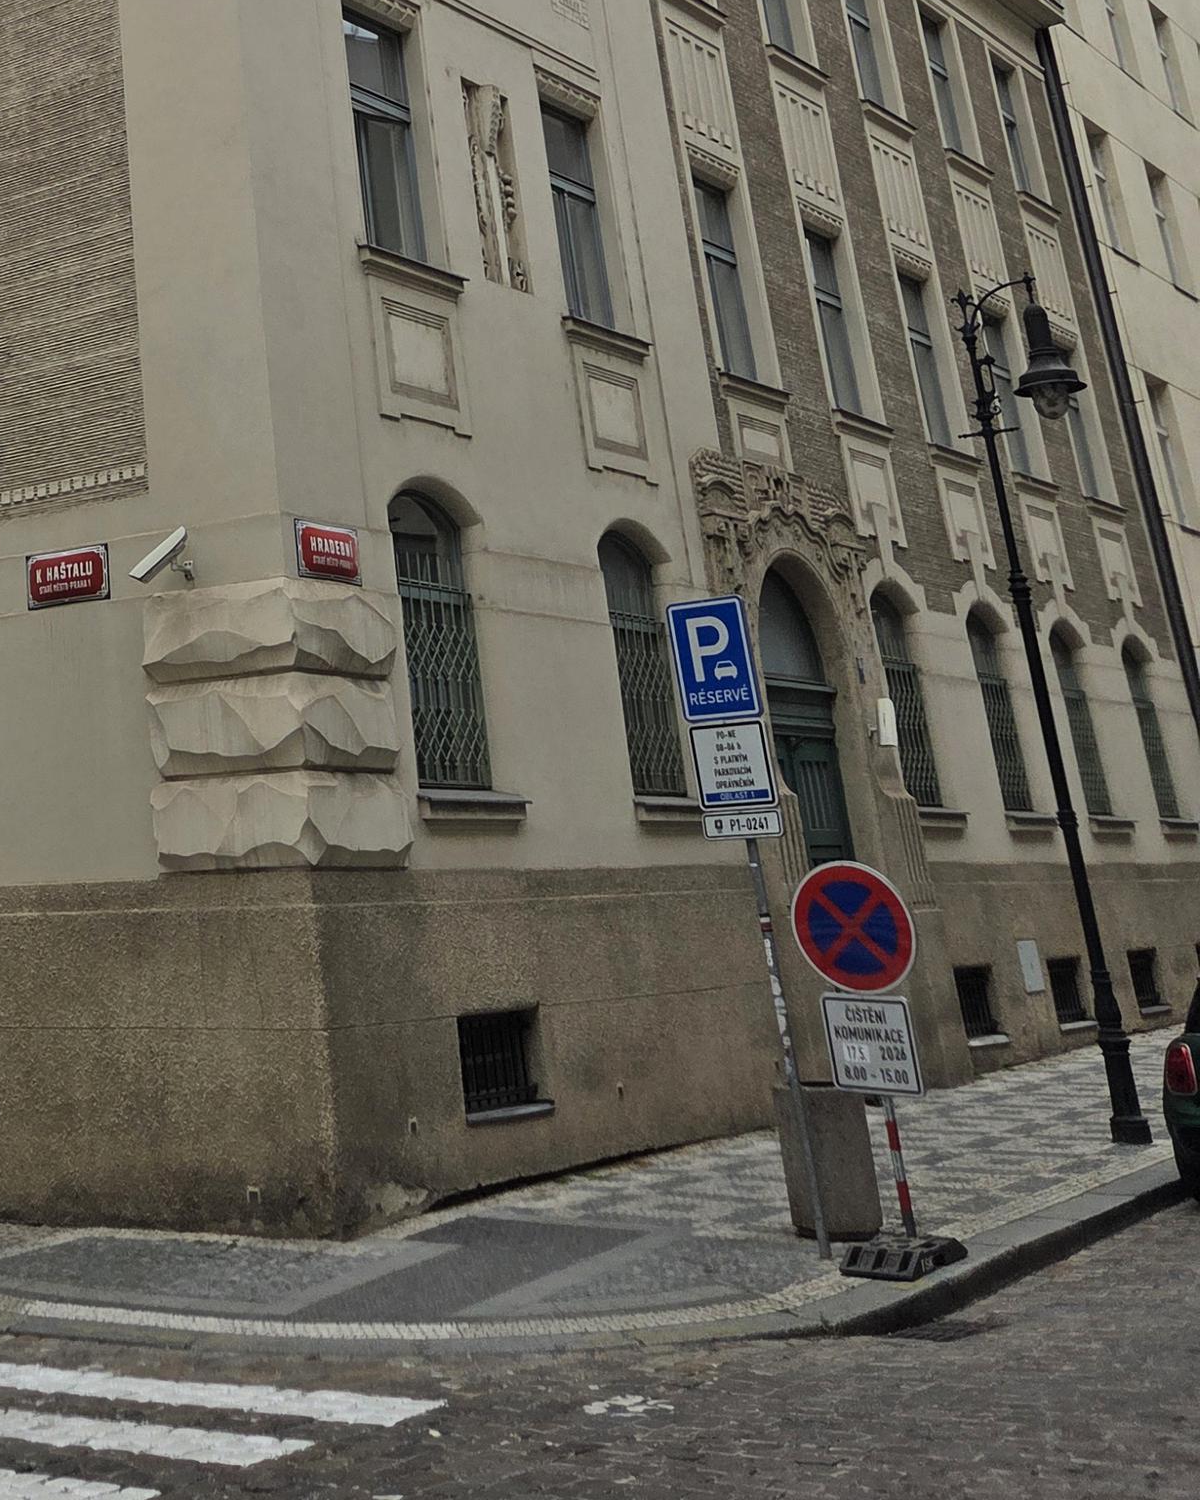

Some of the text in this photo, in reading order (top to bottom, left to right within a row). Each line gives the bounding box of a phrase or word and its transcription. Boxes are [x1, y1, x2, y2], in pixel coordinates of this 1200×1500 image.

[310, 536, 353, 558] HRADEBNÍ
[36, 560, 93, 583] K HAŠTALU
[685, 616, 729, 682] P
[689, 684, 750, 706] RÉSERVÉ
[716, 729, 736, 740] PO-NE
[714, 753, 748, 765] S PLATNÝM
[714, 764, 752, 777] PARKOVACÍM
[720, 790, 748, 801] OBLAST
[845, 1004, 887, 1025] ČIŠTĚNÍ
[833, 1025, 905, 1044] KOMUNIKACE
[844, 1065, 867, 1081] 8.00
[879, 1067, 909, 1085] 15.00
